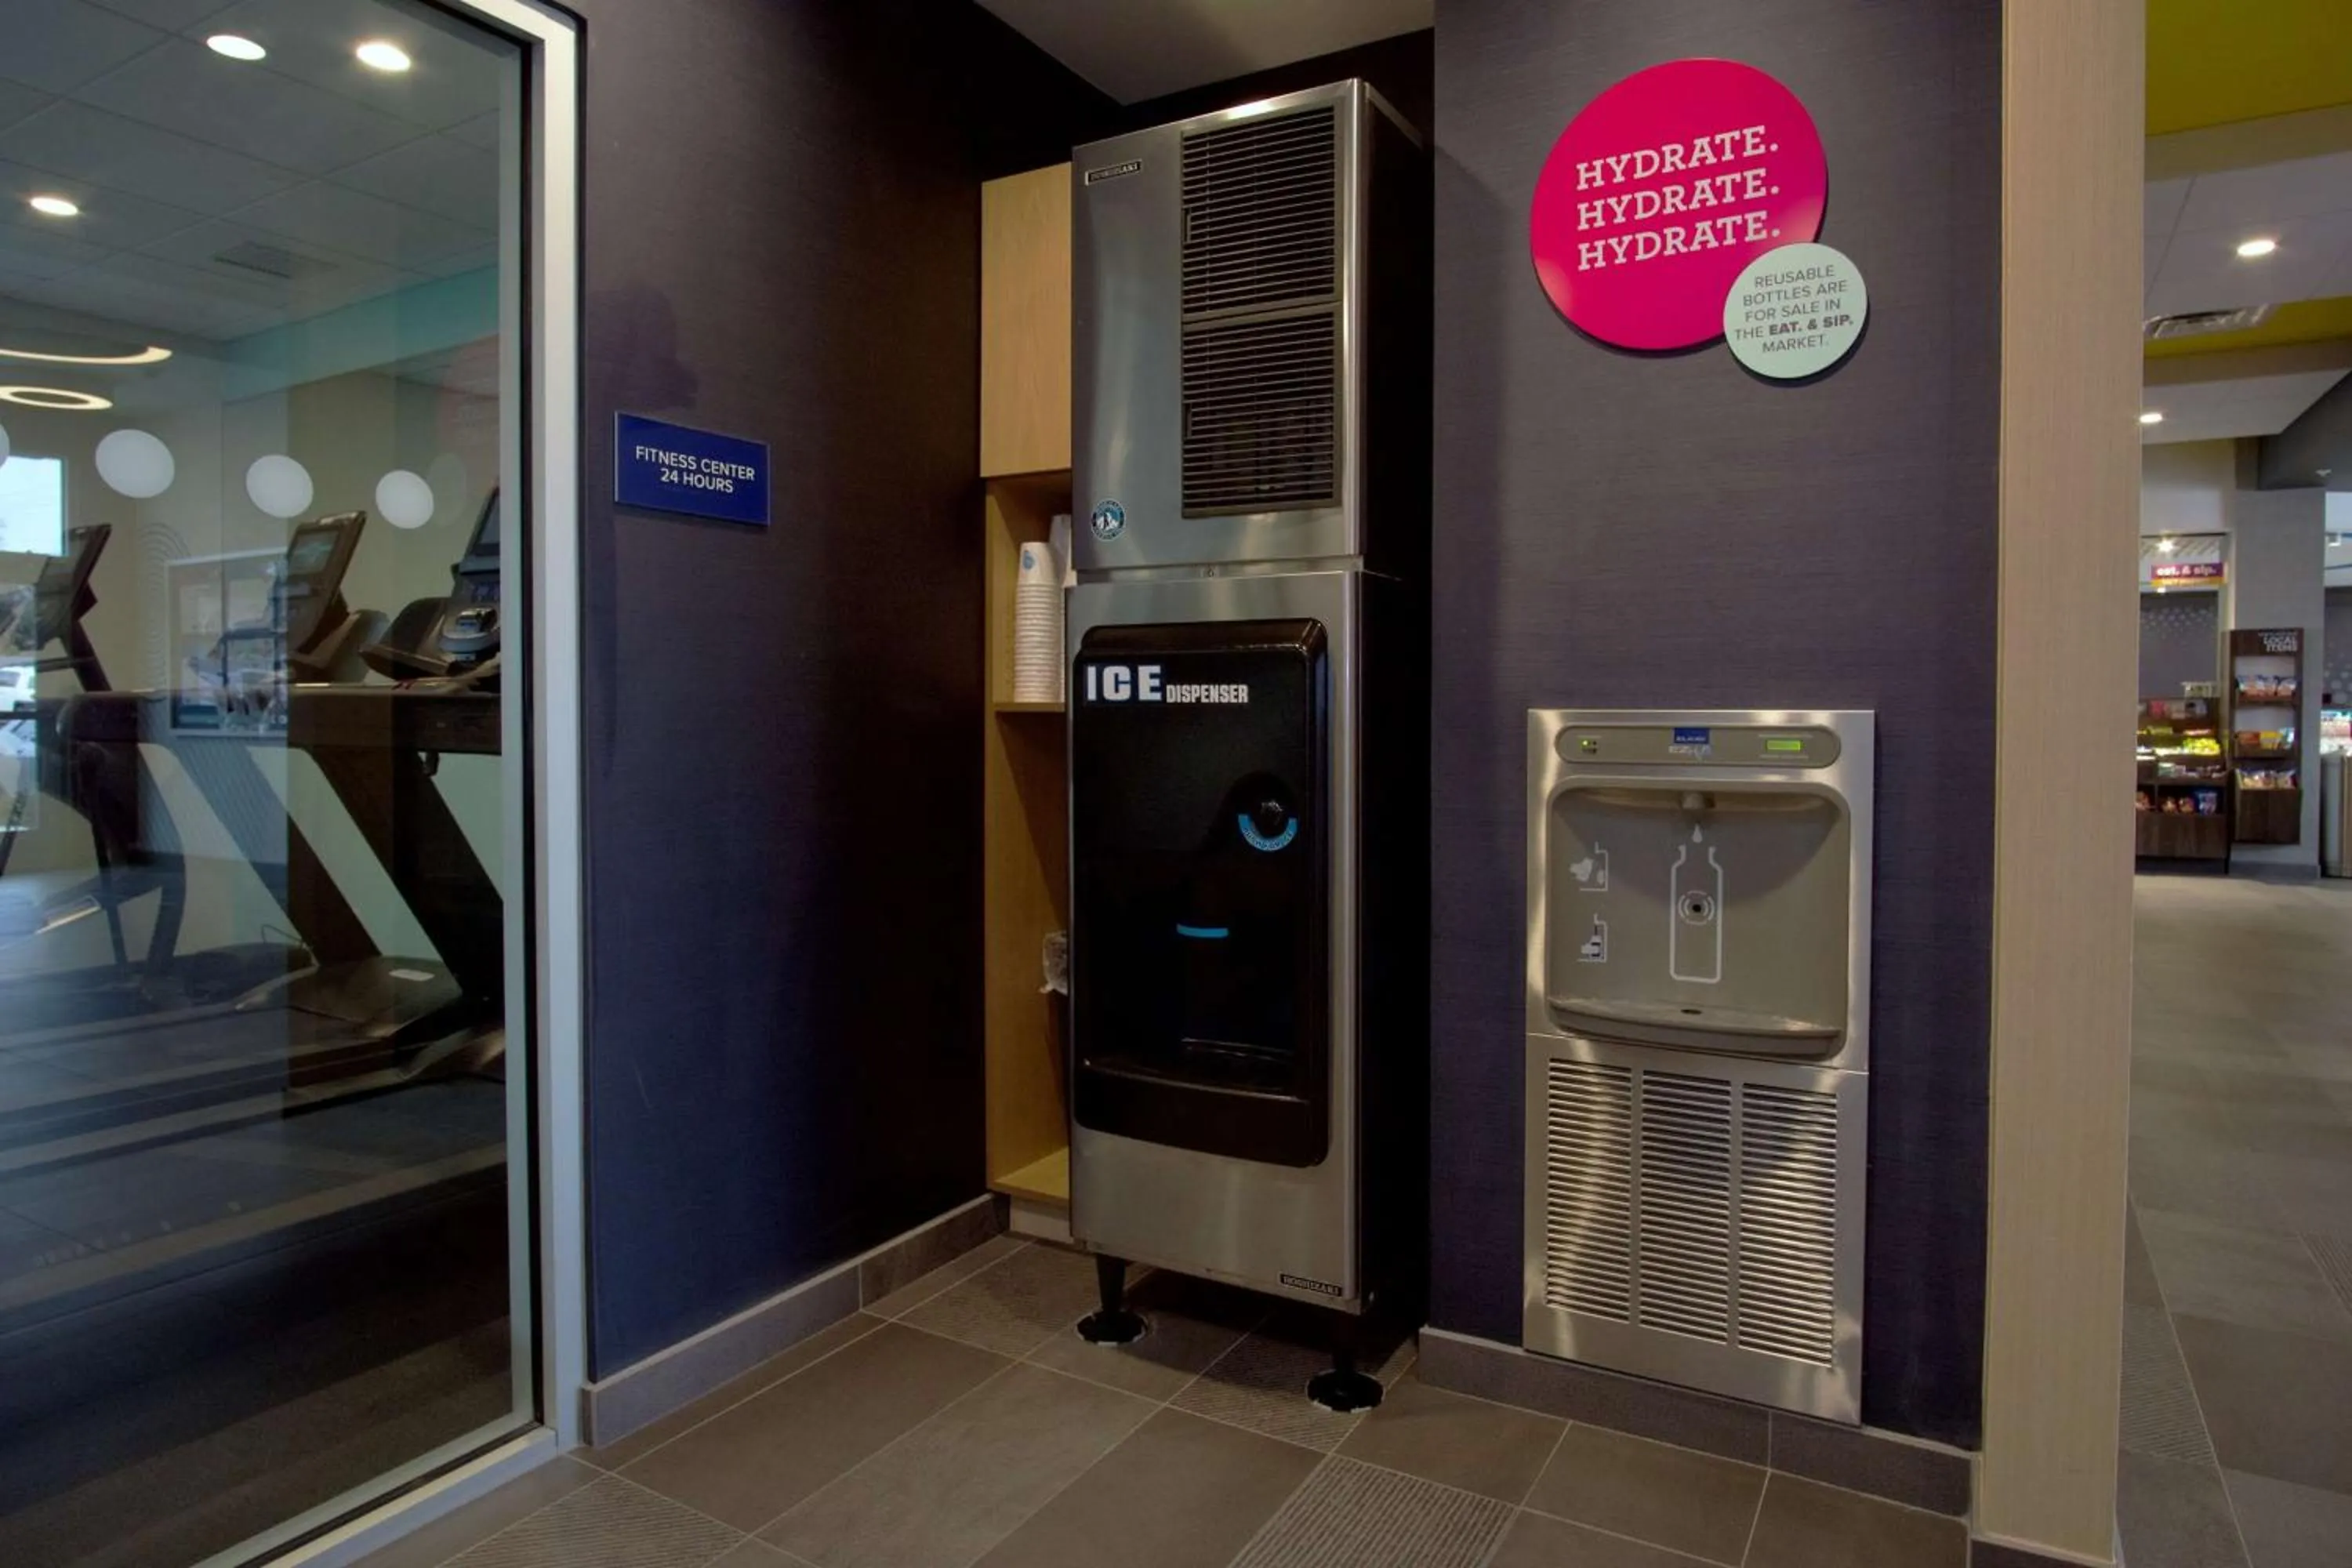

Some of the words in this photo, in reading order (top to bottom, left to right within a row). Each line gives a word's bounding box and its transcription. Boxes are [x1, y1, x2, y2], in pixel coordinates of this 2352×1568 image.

[1577, 125, 1779, 191] HYDRATE.
[1577, 168, 1780, 230] HYDRATE.
[1578, 211, 1780, 270] HYDRATE.
[1755, 264, 1835, 288] REUSABLE
[1743, 285, 1811, 307] BOTTLES
[1817, 280, 1848, 296] ARE
[1744, 308, 1776, 322] FOR
[1781, 301, 1820, 318] SALE
[1825, 299, 1840, 311] IN
[1735, 326, 1764, 339] THE
[1769, 321, 1802, 336] EAT.
[1807, 318, 1817, 330] &
[1823, 314, 1853, 328] SIP.
[636, 445, 697, 470] FITNESS
[701, 459, 755, 481] CENTER
[660, 468, 678, 483] 24
[683, 471, 734, 493] HOURS
[1087, 665, 1162, 702] ICE
[1166, 684, 1249, 703] DISPENSER
